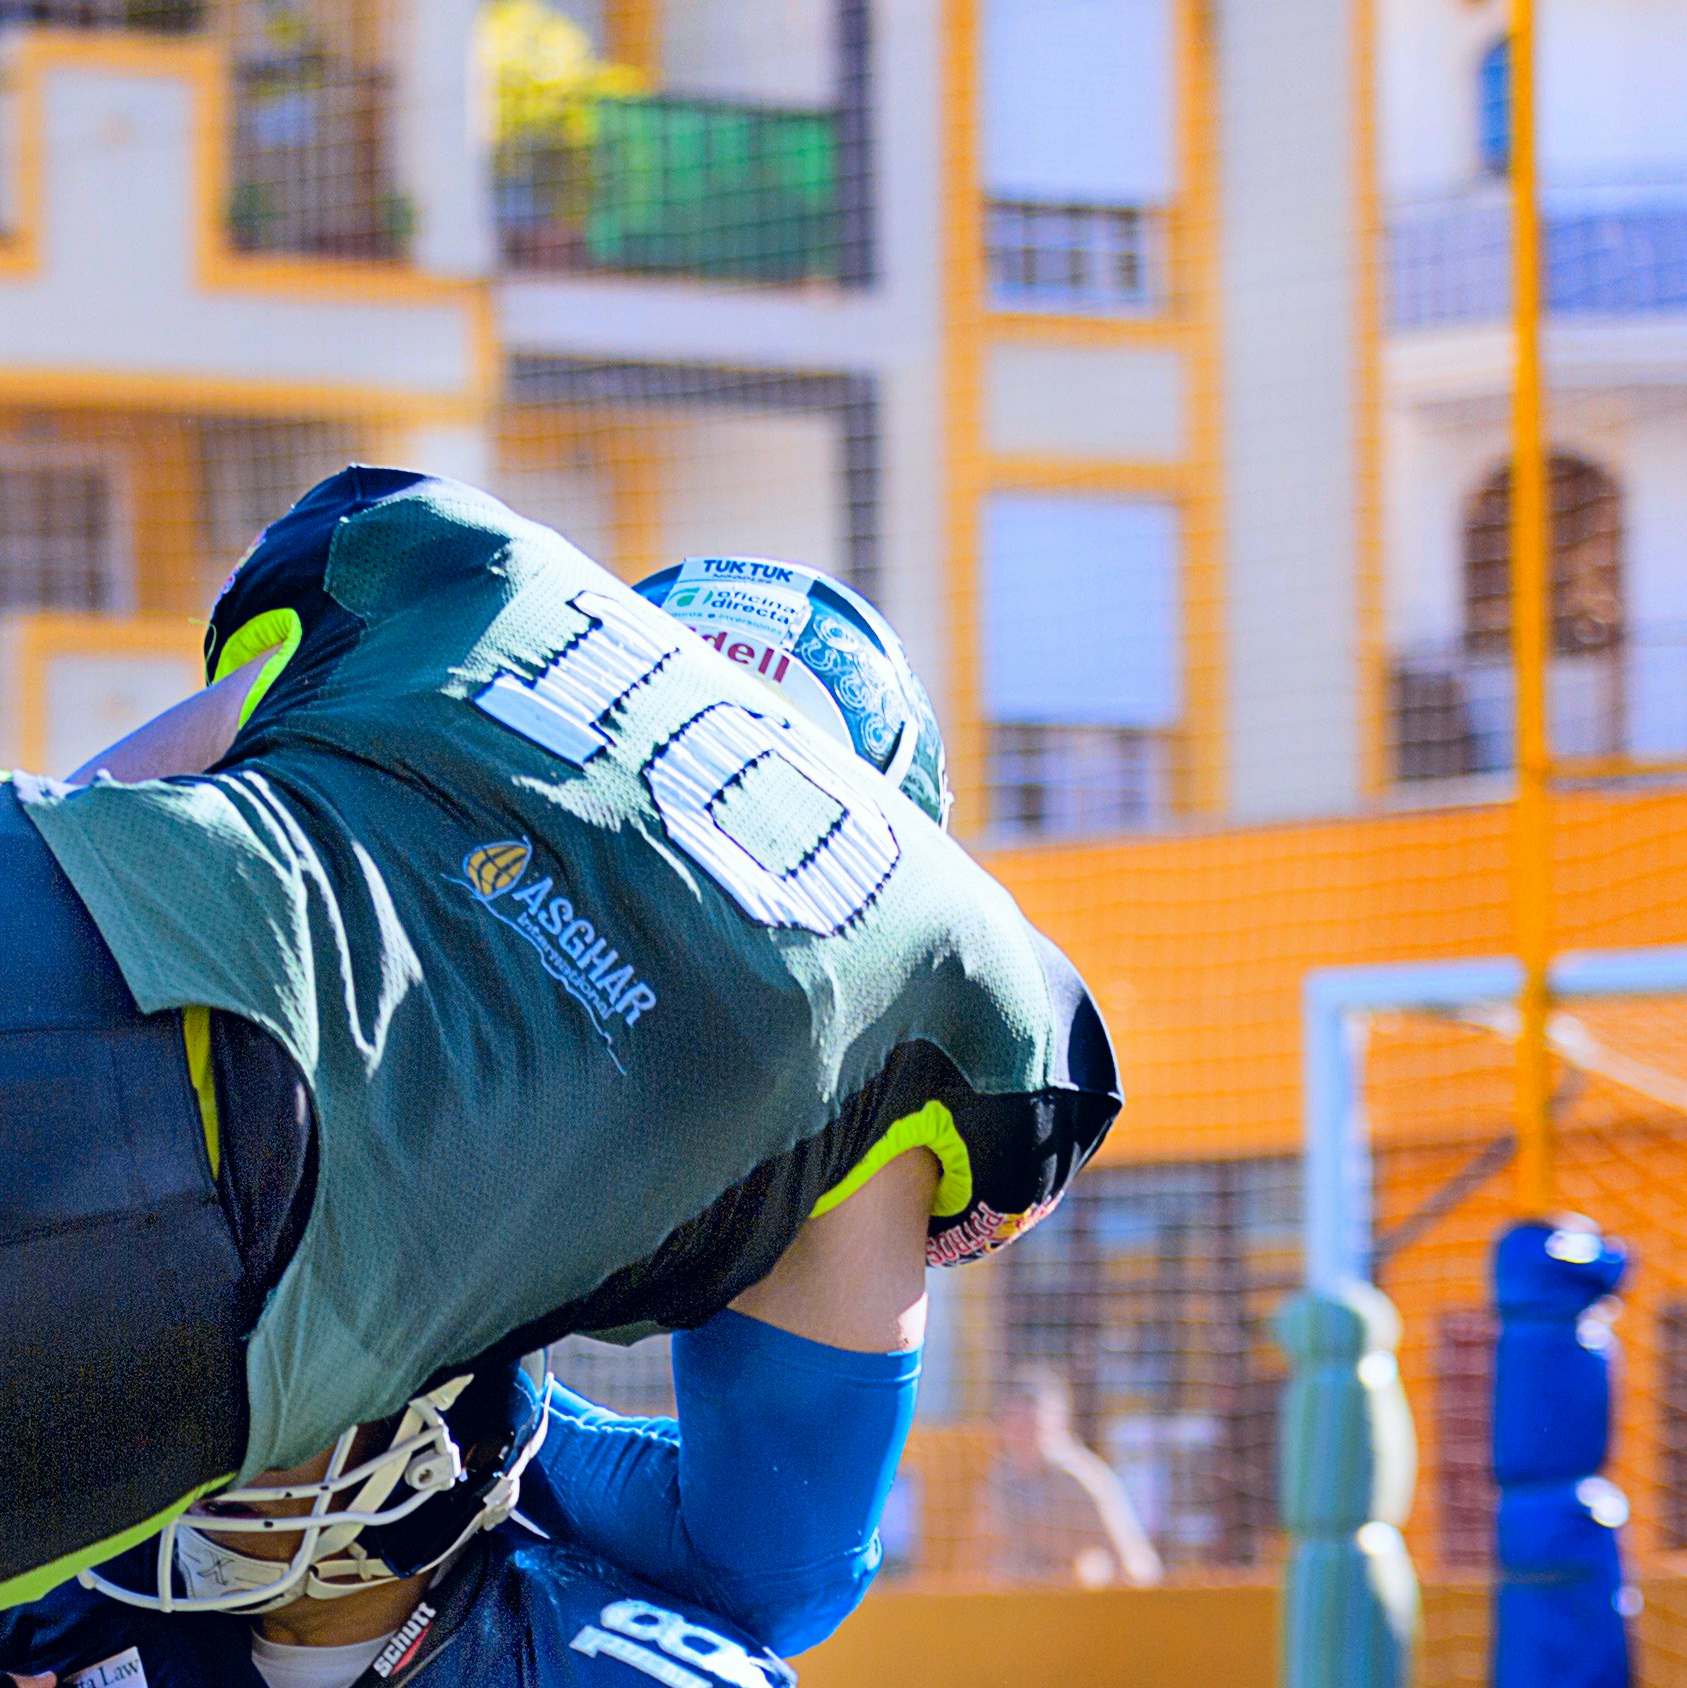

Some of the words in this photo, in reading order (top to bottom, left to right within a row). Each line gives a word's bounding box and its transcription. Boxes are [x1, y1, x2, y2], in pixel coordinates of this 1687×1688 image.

[703, 559, 746, 574] TUK
[750, 562, 793, 583] TUK
[711, 597, 790, 625] directa
[717, 590, 797, 615] oficina
[687, 626, 790, 684] dell
[475, 590, 901, 938] 10
[511, 875, 657, 1029] ASGHAR
[926, 1201, 1005, 1265] POTROS
[372, 1601, 437, 1679] schutt
[98, 1659, 140, 1687] Law
